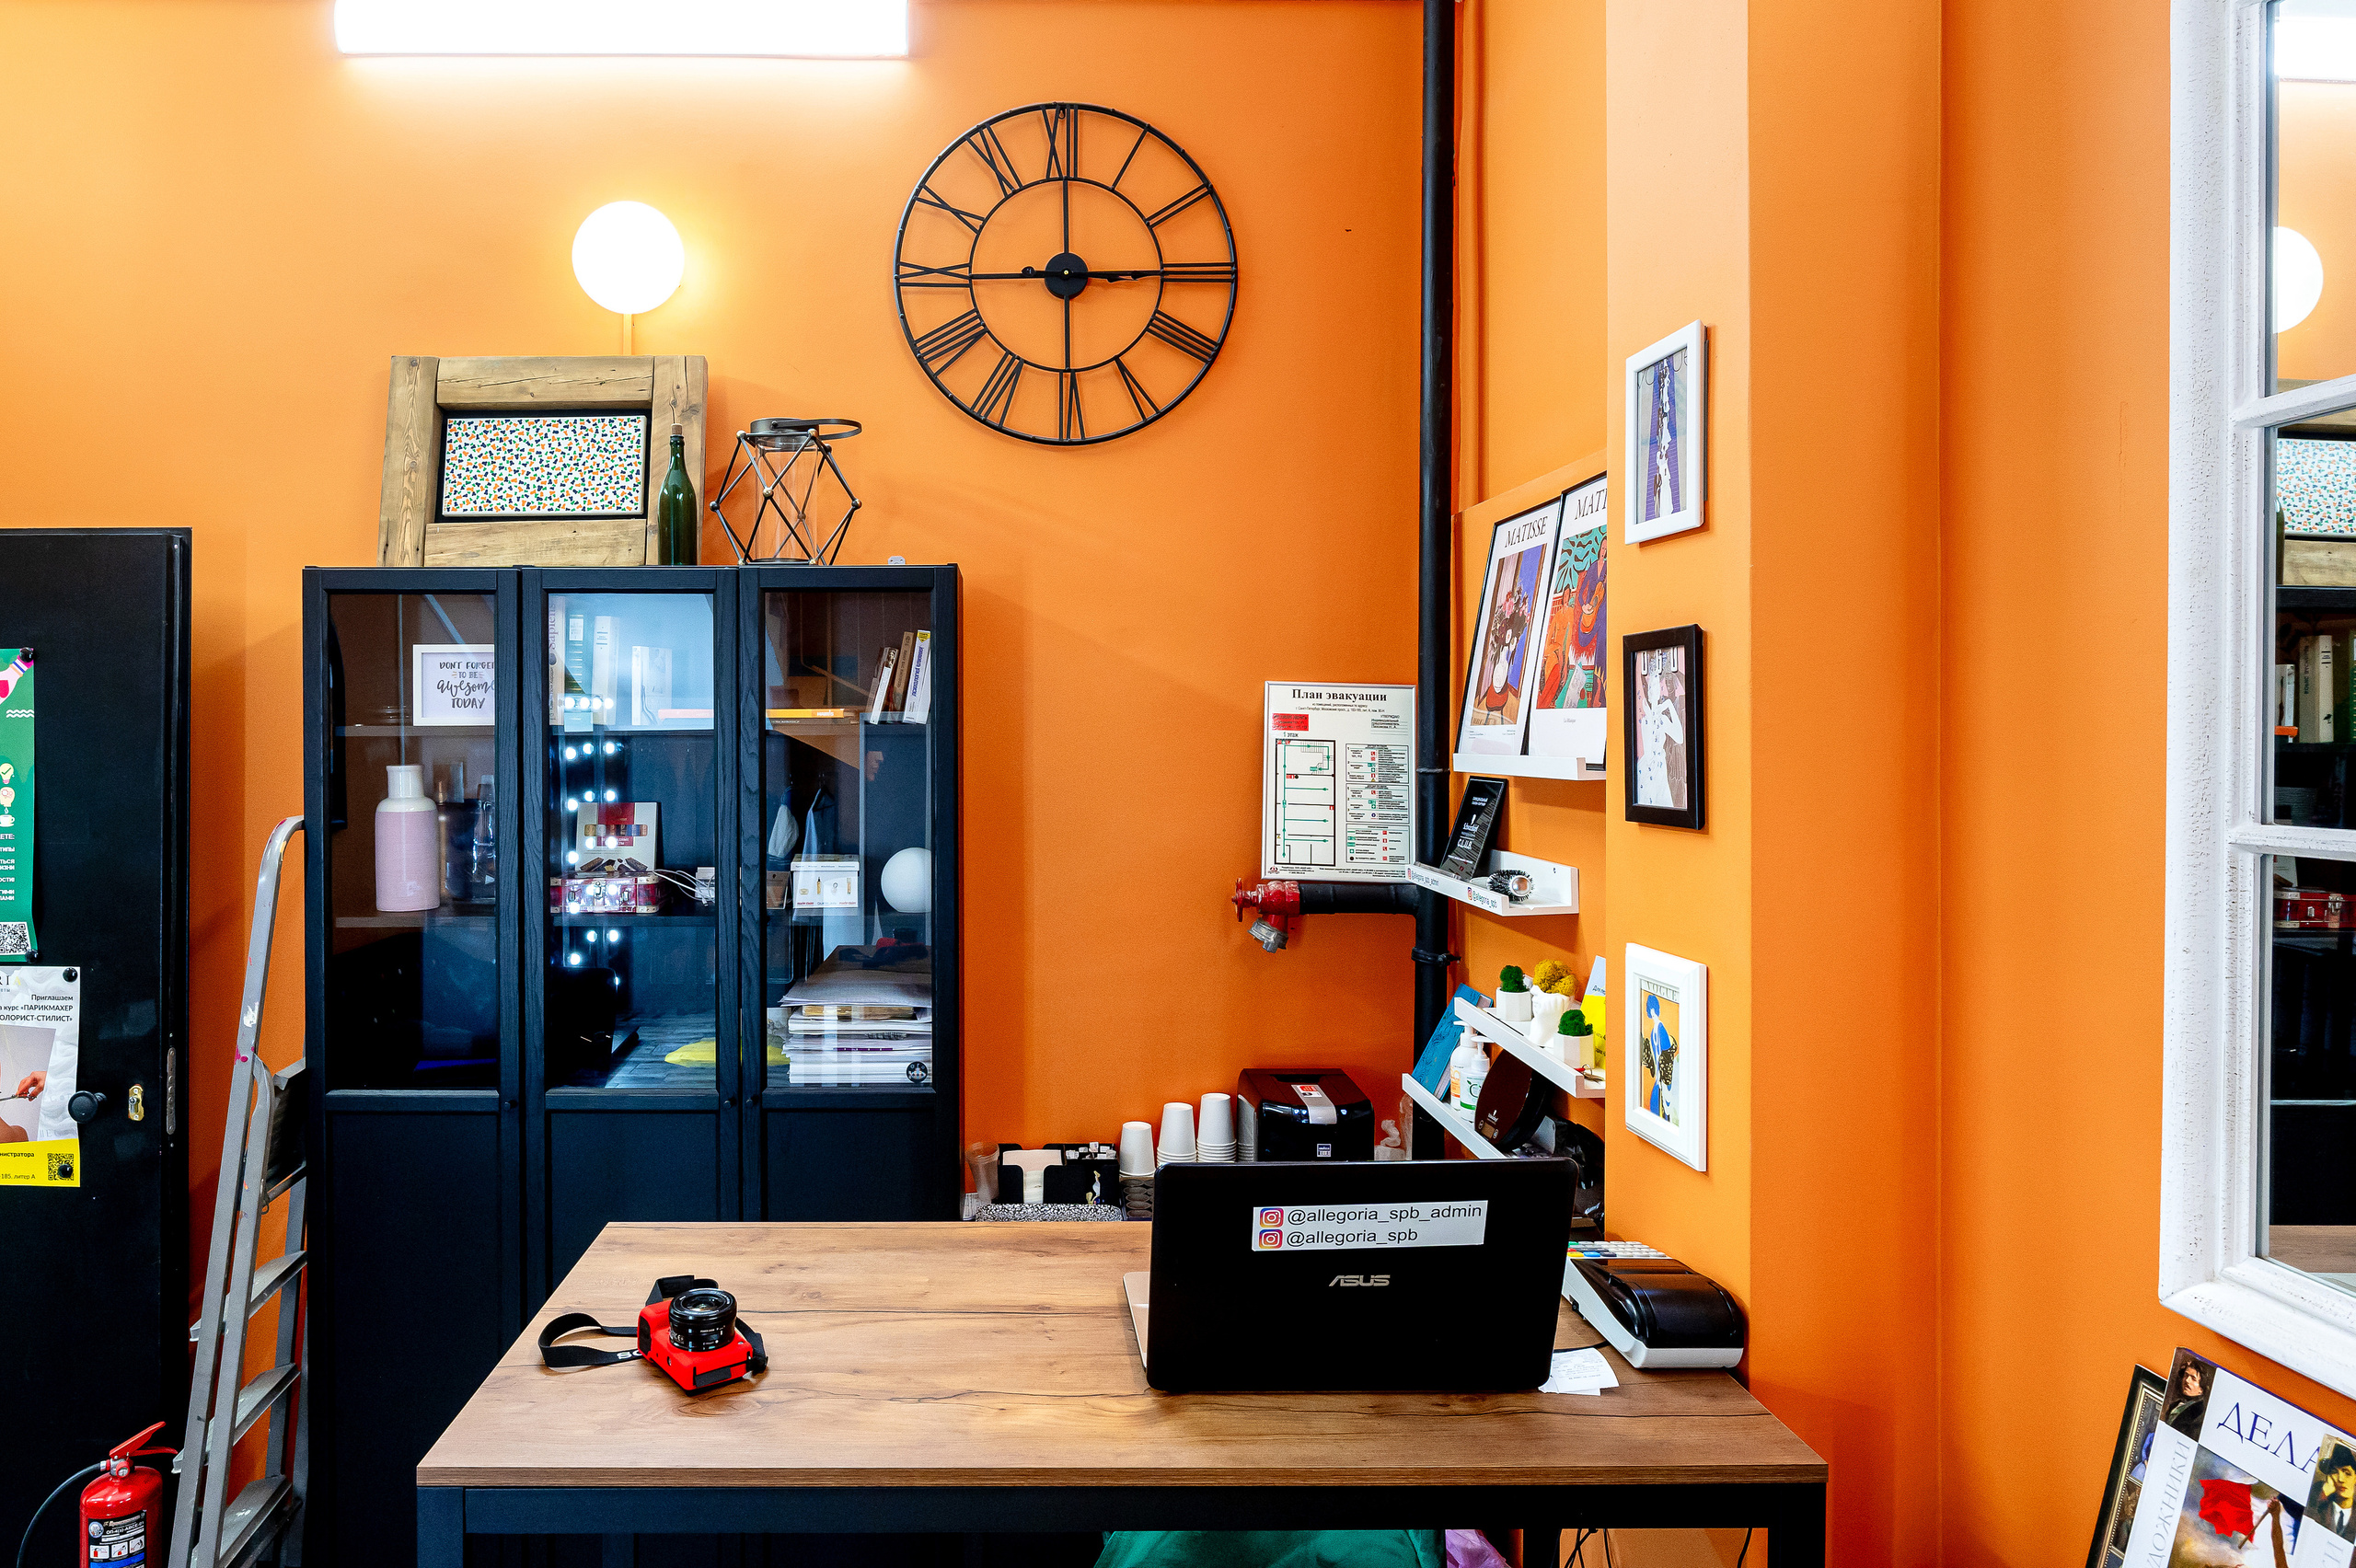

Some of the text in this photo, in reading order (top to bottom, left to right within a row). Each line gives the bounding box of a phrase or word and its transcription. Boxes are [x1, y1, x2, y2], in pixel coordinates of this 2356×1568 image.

[1505, 516, 1548, 548] MATISSE
[451, 698, 485, 709] TODAY
[1292, 688, 1387, 703] План эвакуации
[1646, 981, 1678, 1002] VOGUE
[1288, 1205, 1483, 1226] @allegoria_spb_admin
[1287, 1228, 1418, 1247] @allegoria_spb
[1328, 1274, 1391, 1287] ASUS
